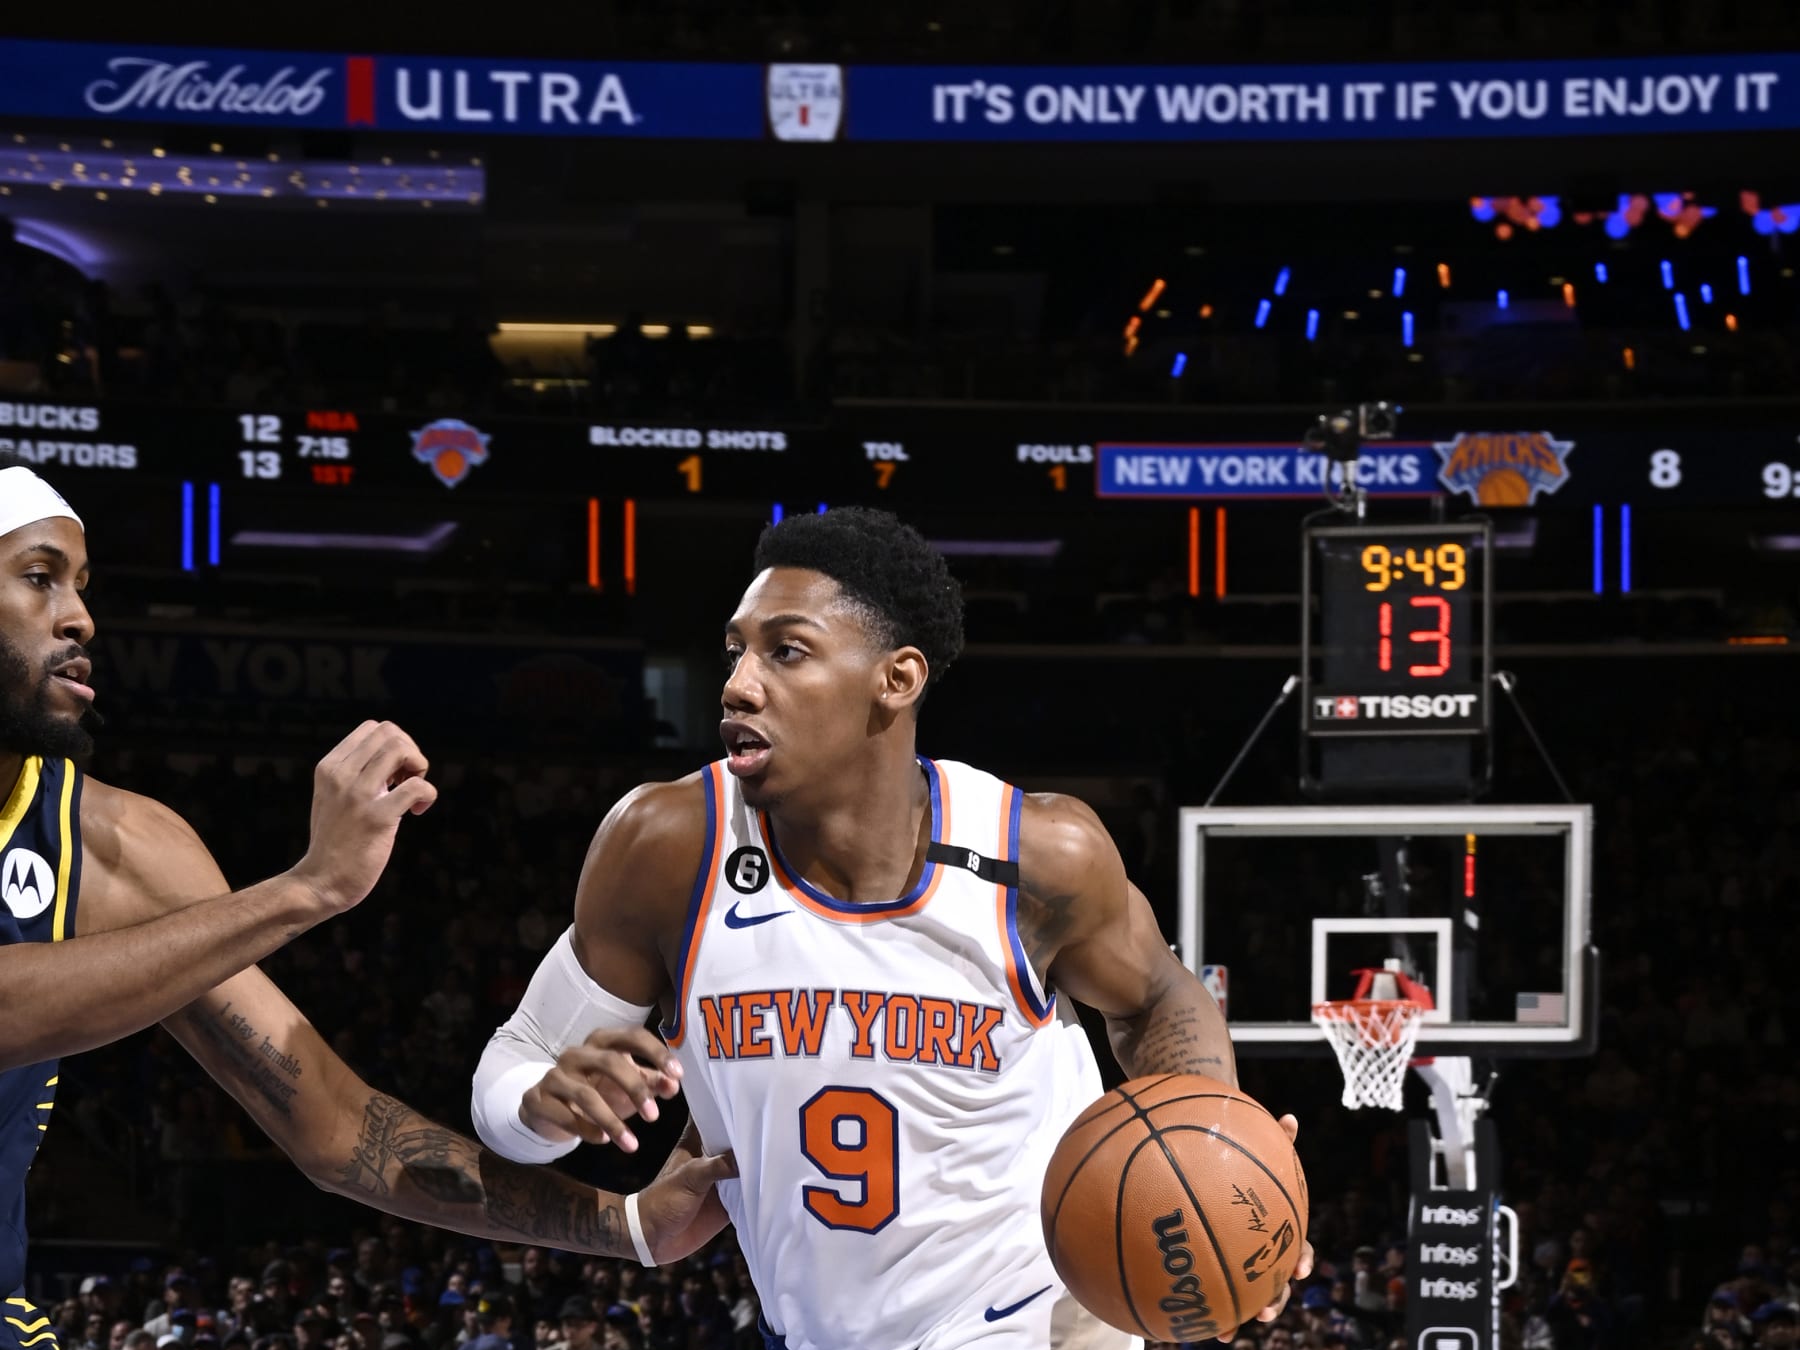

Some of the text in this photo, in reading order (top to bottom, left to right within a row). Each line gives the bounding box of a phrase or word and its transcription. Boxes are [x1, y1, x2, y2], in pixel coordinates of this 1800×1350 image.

[84, 56, 638, 125] Michelob ULTRA
[933, 73, 1779, 123] IT'S ONLY WORTH IT IF YOU ENJOY IT
[0, 402, 99, 431] BUCKS
[238, 414, 282, 443] 12
[306, 410, 359, 432] NBA
[297, 436, 349, 459] 7:15
[589, 425, 788, 451] BLOCKED SHOTS
[863, 442, 909, 461] TOL
[238, 450, 282, 479] 13
[1017, 443, 1094, 464] FOULS
[311, 465, 354, 485] 1ST
[678, 454, 703, 493] 1
[872, 461, 896, 489] 7
[1047, 463, 1068, 492] 1
[1114, 454, 1420, 486] NEW YORK KNCKS
[1650, 449, 1682, 489] 8
[1361, 543, 1467, 592] 9:49
[1378, 595, 1452, 678] 13
[1359, 694, 1478, 719] TISSOT
[734, 853, 762, 889] 6
[966, 851, 980, 872] 19
[699, 988, 1005, 1074] NEW YORK
[230, 1013, 258, 1041] stay
[258, 1035, 303, 1080] humble
[799, 1085, 901, 1236] 9
[1421, 1205, 1480, 1227] Infosys
[1420, 1243, 1479, 1267] Infosys
[1152, 1208, 1219, 1342] Wilson
[1420, 1277, 1479, 1301] Infosys
